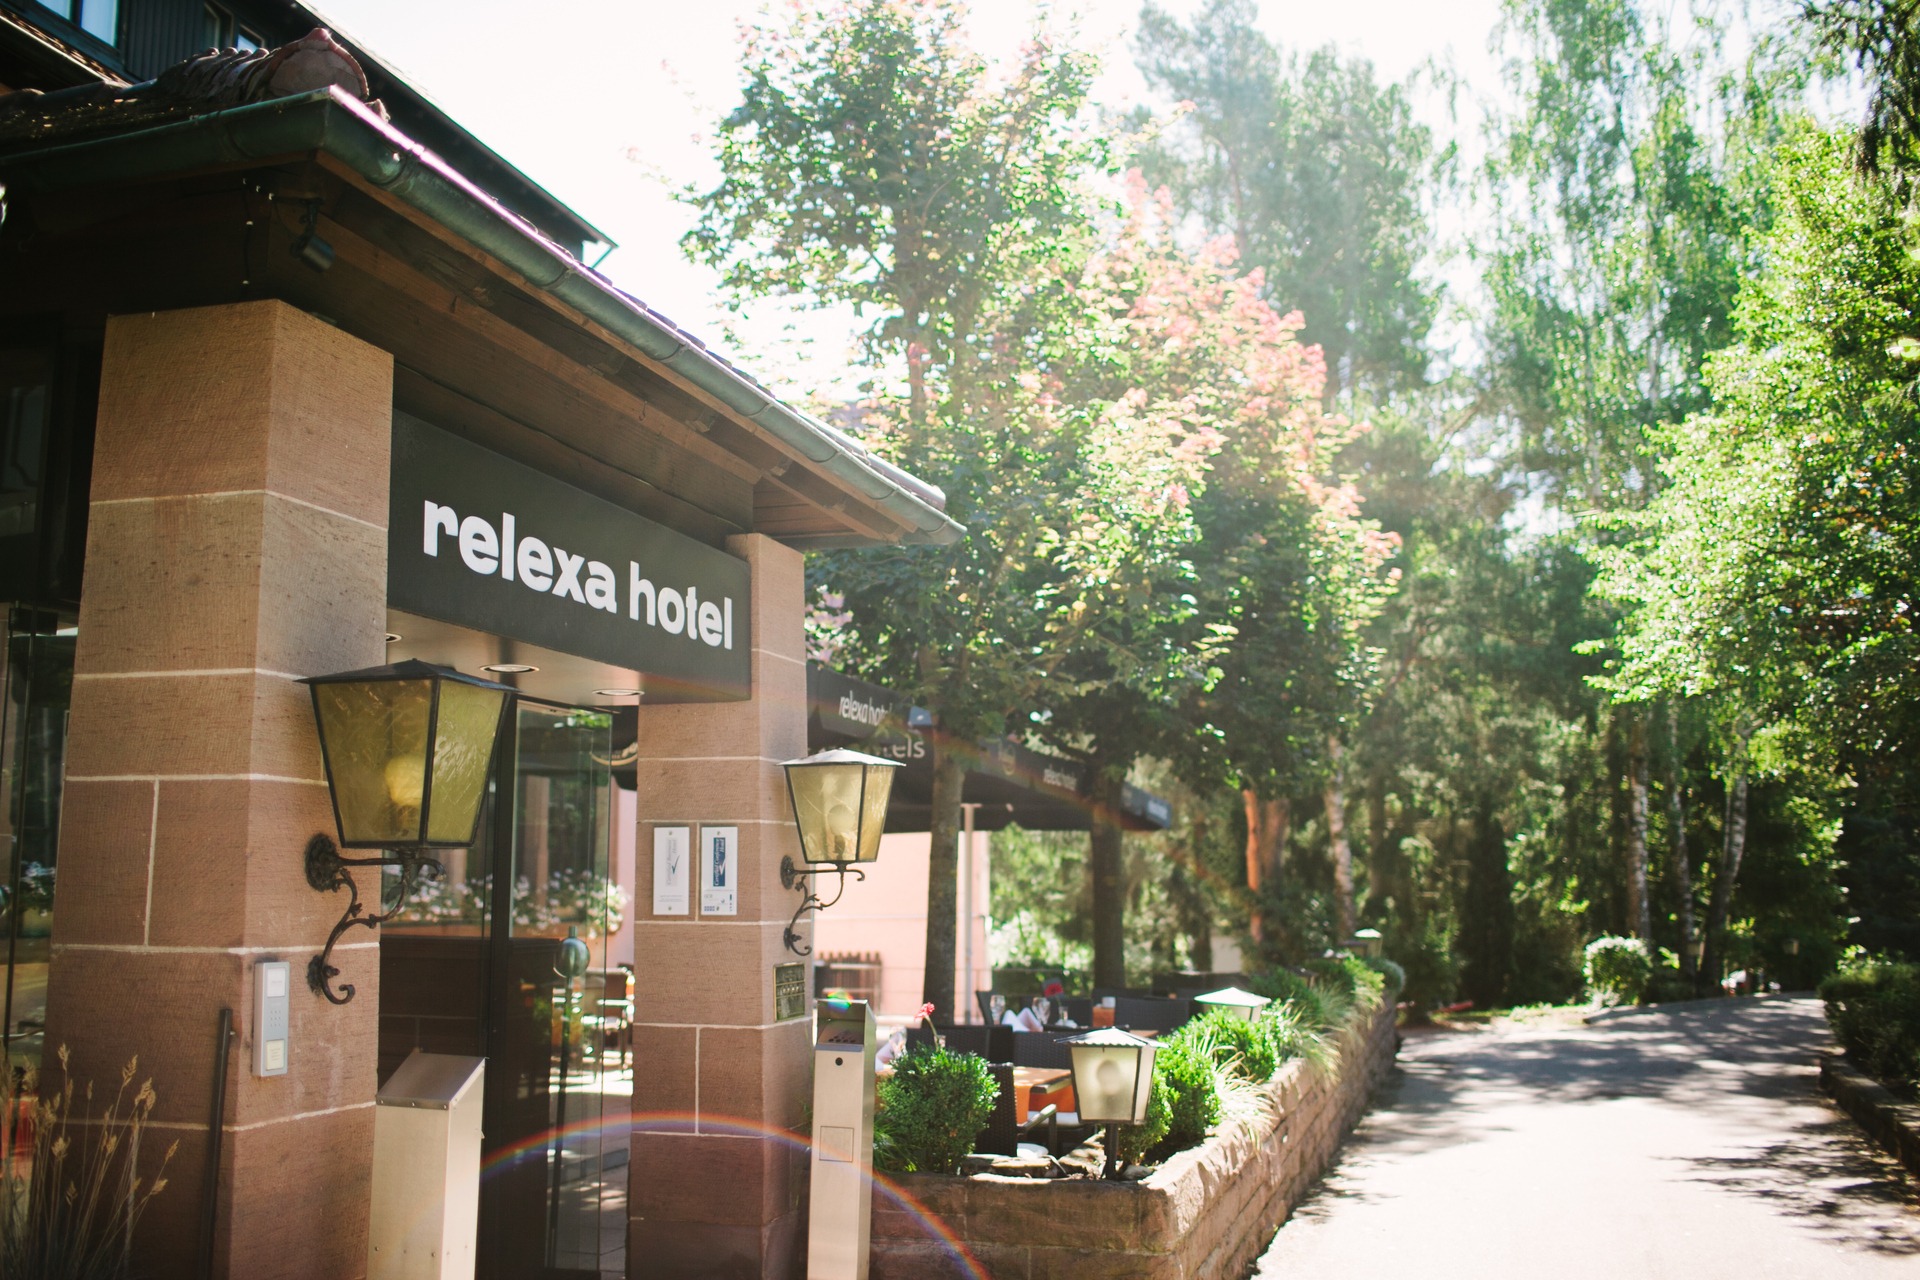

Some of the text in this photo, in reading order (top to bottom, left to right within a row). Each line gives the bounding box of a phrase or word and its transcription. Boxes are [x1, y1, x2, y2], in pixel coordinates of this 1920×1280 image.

[423, 500, 732, 650] relexa hotel
[839, 690, 868, 724] relexa
